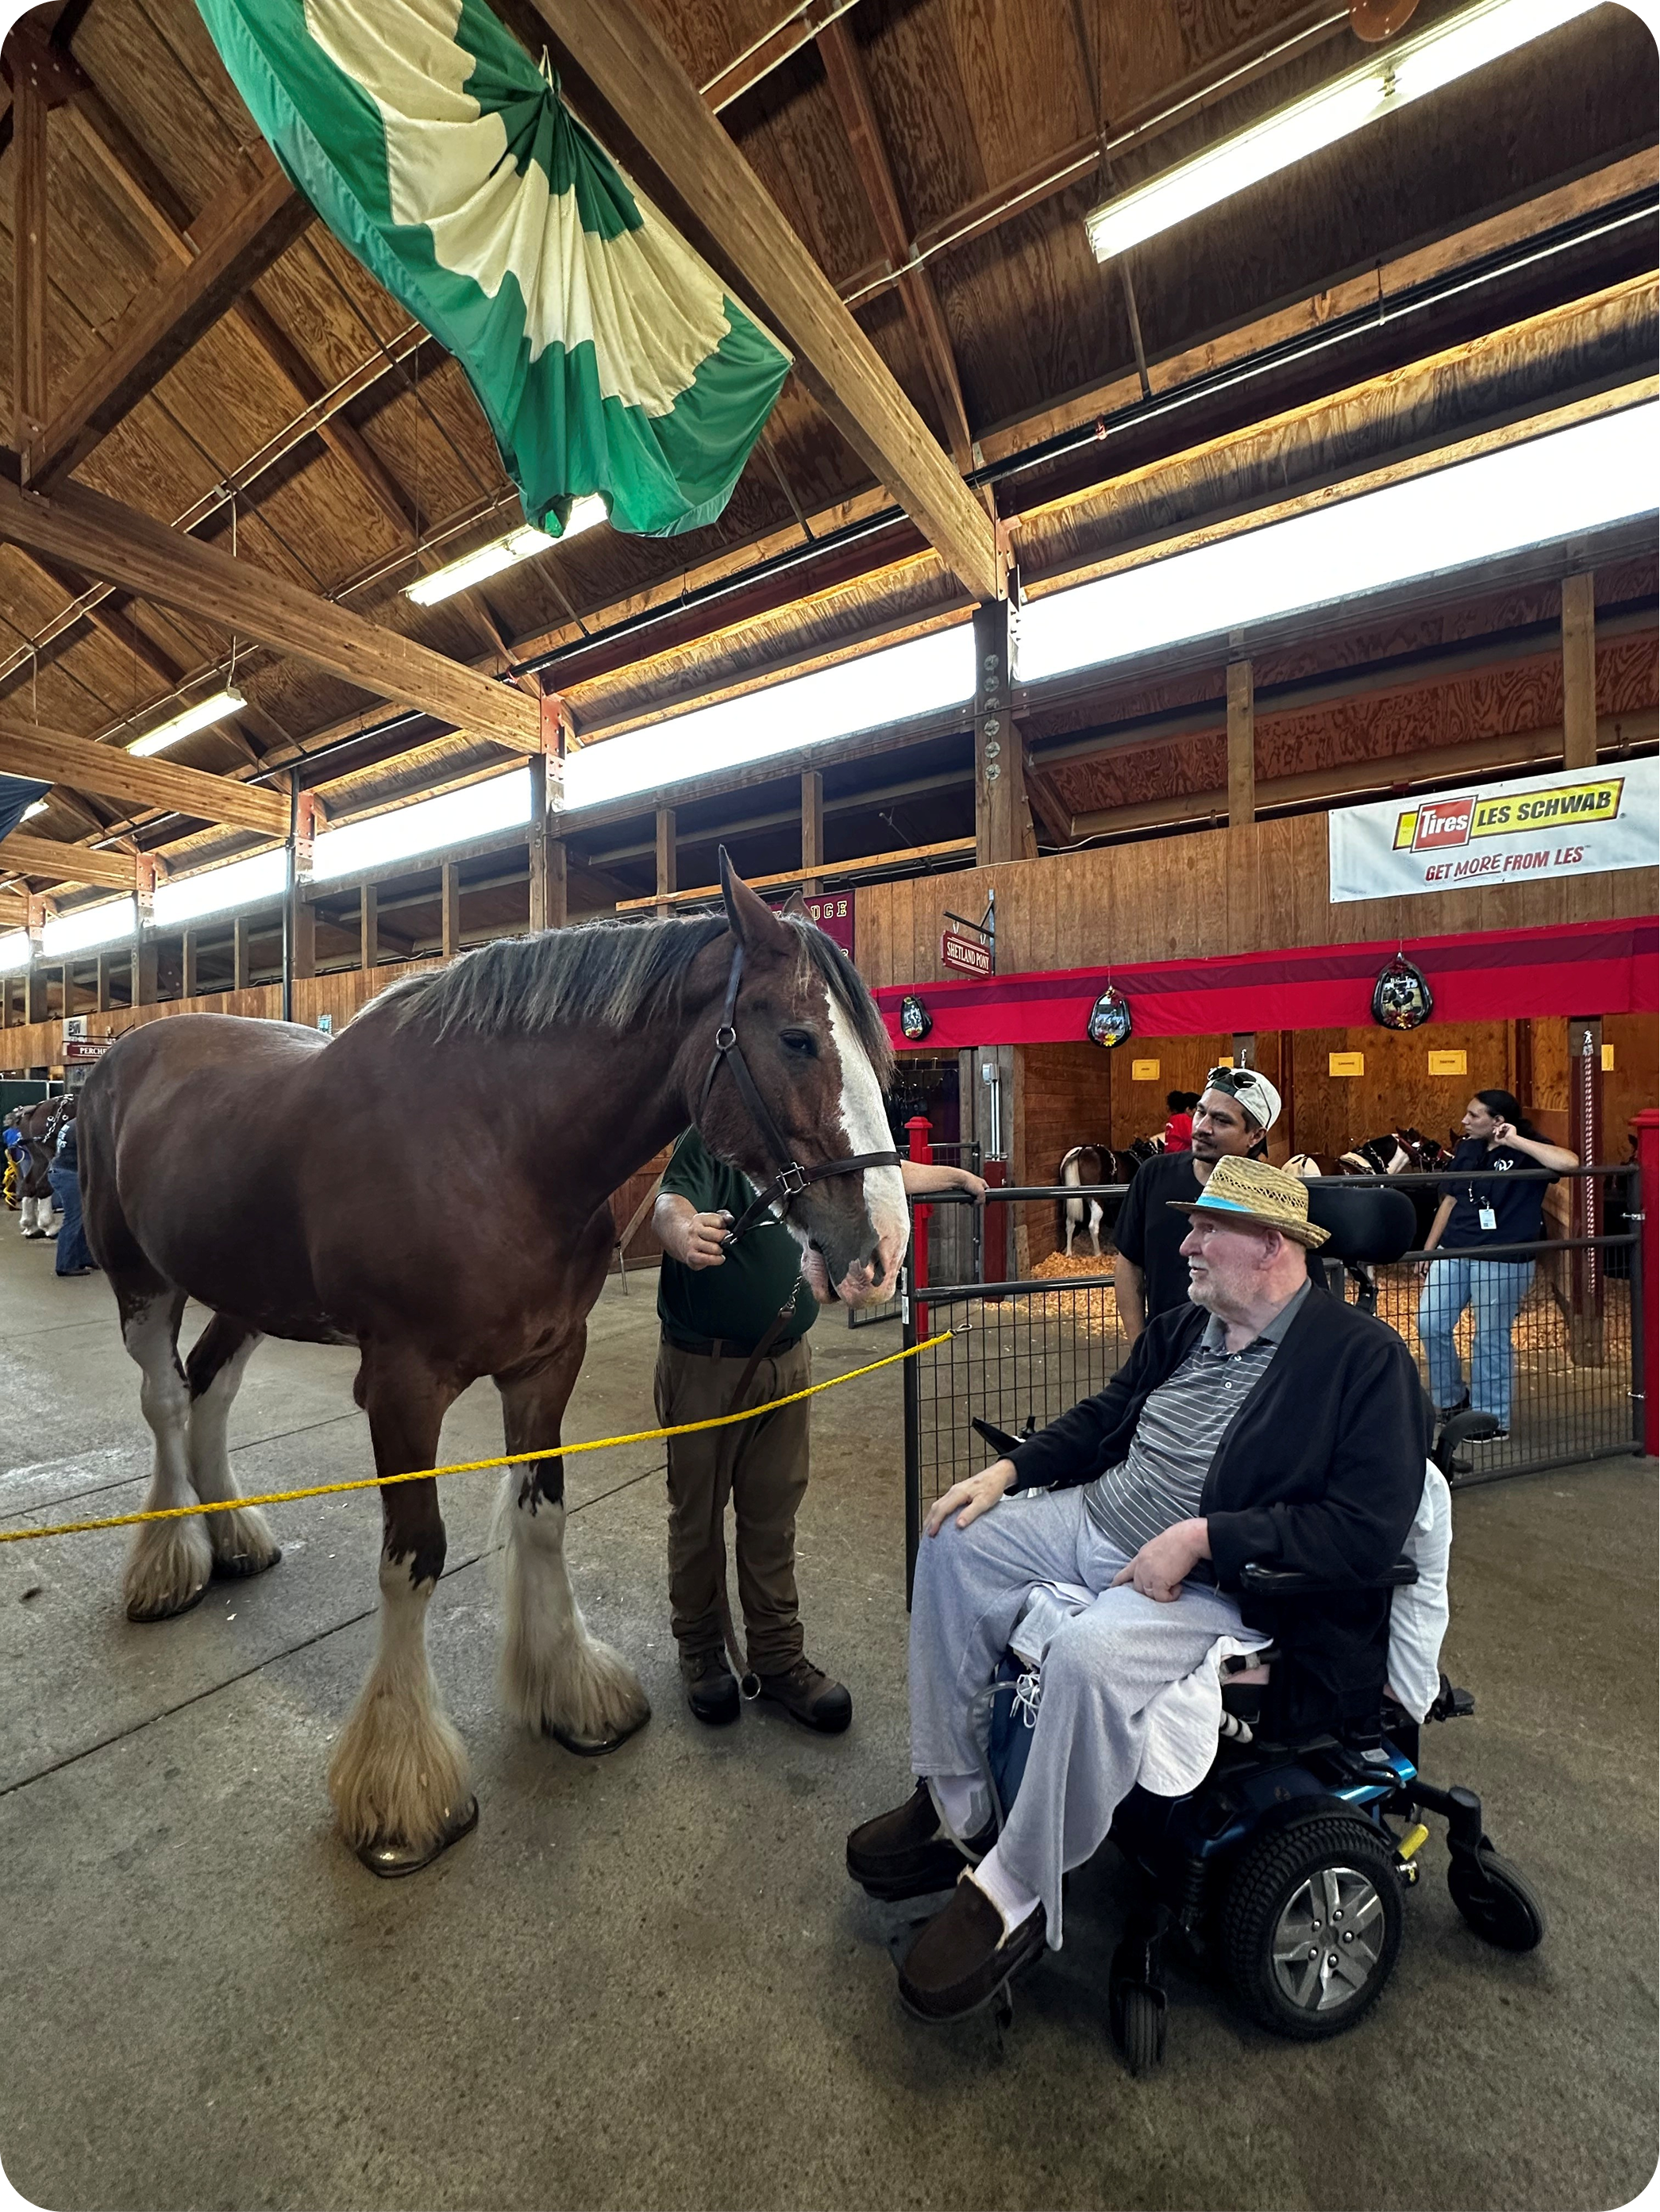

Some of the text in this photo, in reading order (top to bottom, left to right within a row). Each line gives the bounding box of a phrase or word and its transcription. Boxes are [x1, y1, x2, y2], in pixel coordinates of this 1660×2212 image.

[1421, 809, 1469, 838] Tires
[1477, 791, 1612, 827] LES SCHWAB
[1425, 846, 1585, 882] GET MORE FROM LES
[946, 941, 990, 970] SHETLAND PONY
